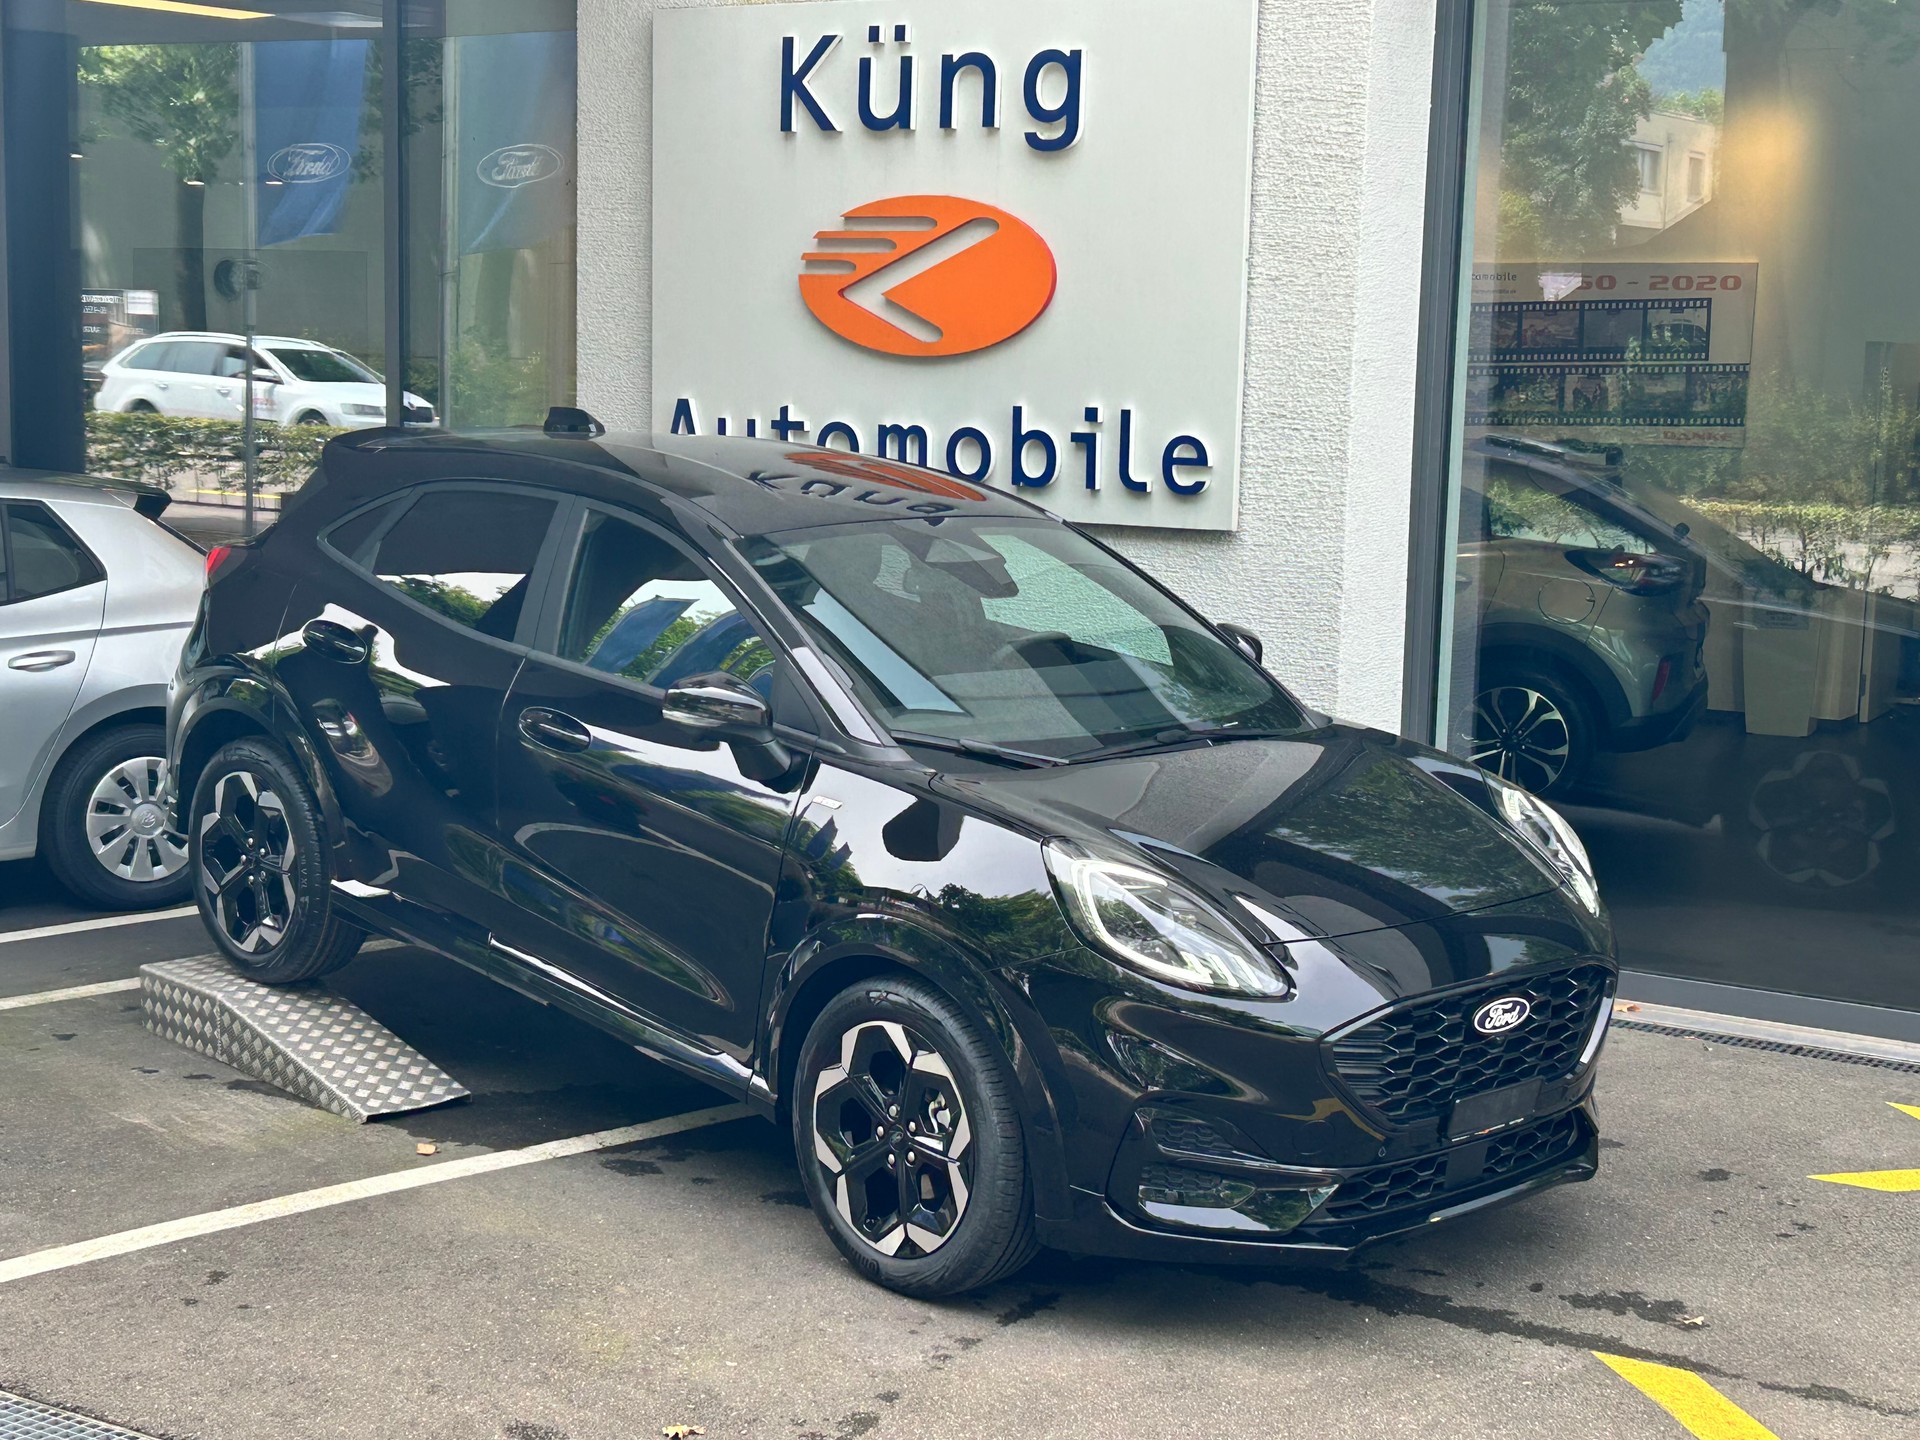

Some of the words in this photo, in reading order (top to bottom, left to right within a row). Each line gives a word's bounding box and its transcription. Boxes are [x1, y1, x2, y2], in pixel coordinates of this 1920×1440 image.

[780, 24, 1084, 152] Küng
[1649, 275, 1742, 291] 2020
[1485, 1002, 1520, 1029] Ford
